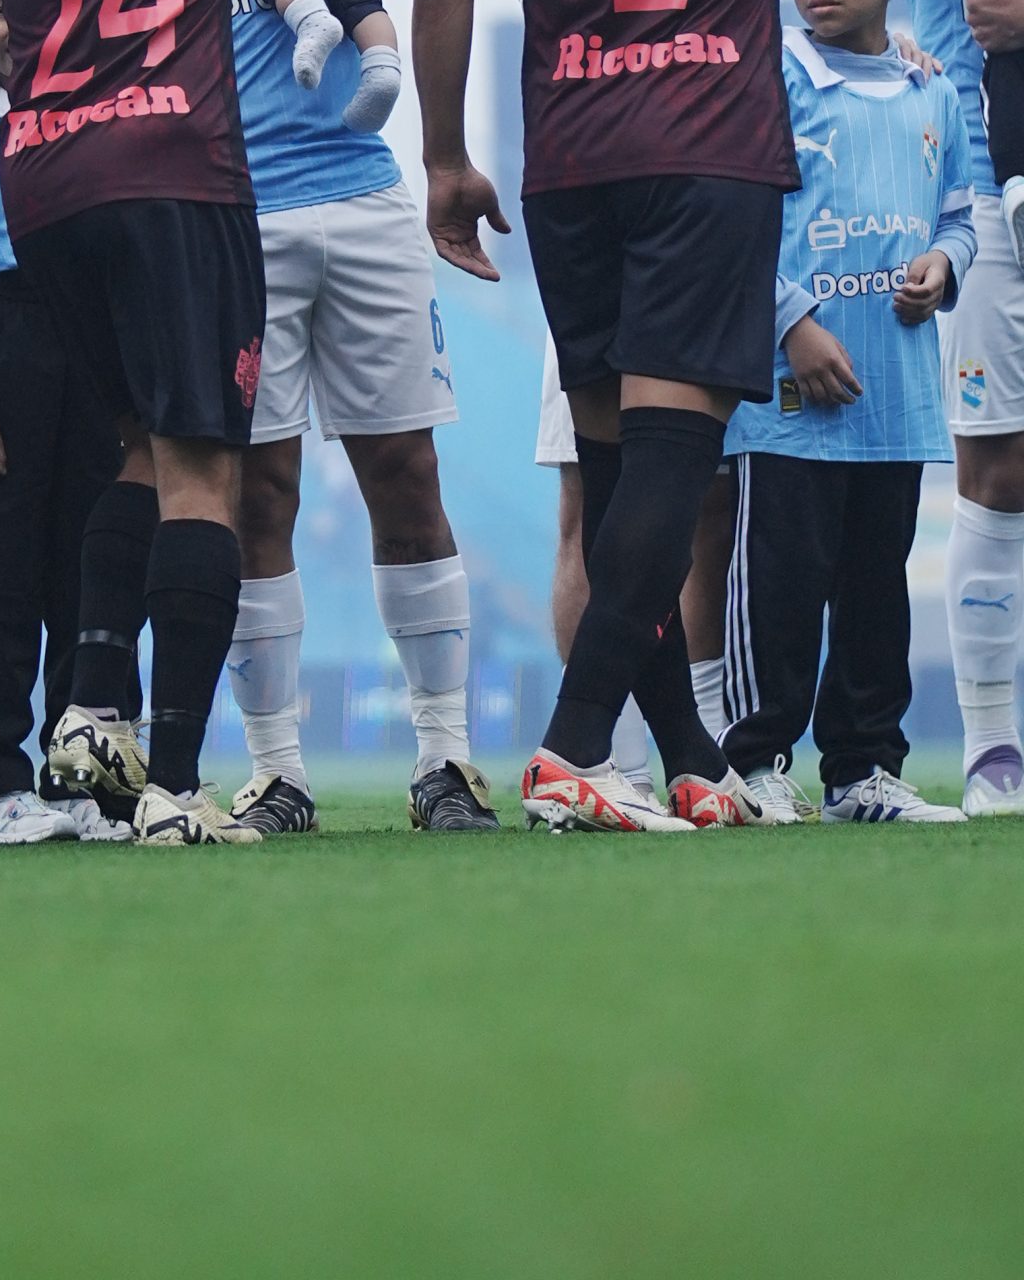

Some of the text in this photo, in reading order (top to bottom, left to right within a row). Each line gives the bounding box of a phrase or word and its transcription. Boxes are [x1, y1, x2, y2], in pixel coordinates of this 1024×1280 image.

[552, 32, 740, 81] Ricocan
[846, 214, 907, 237] CAJA
[812, 261, 911, 301] Dorad
